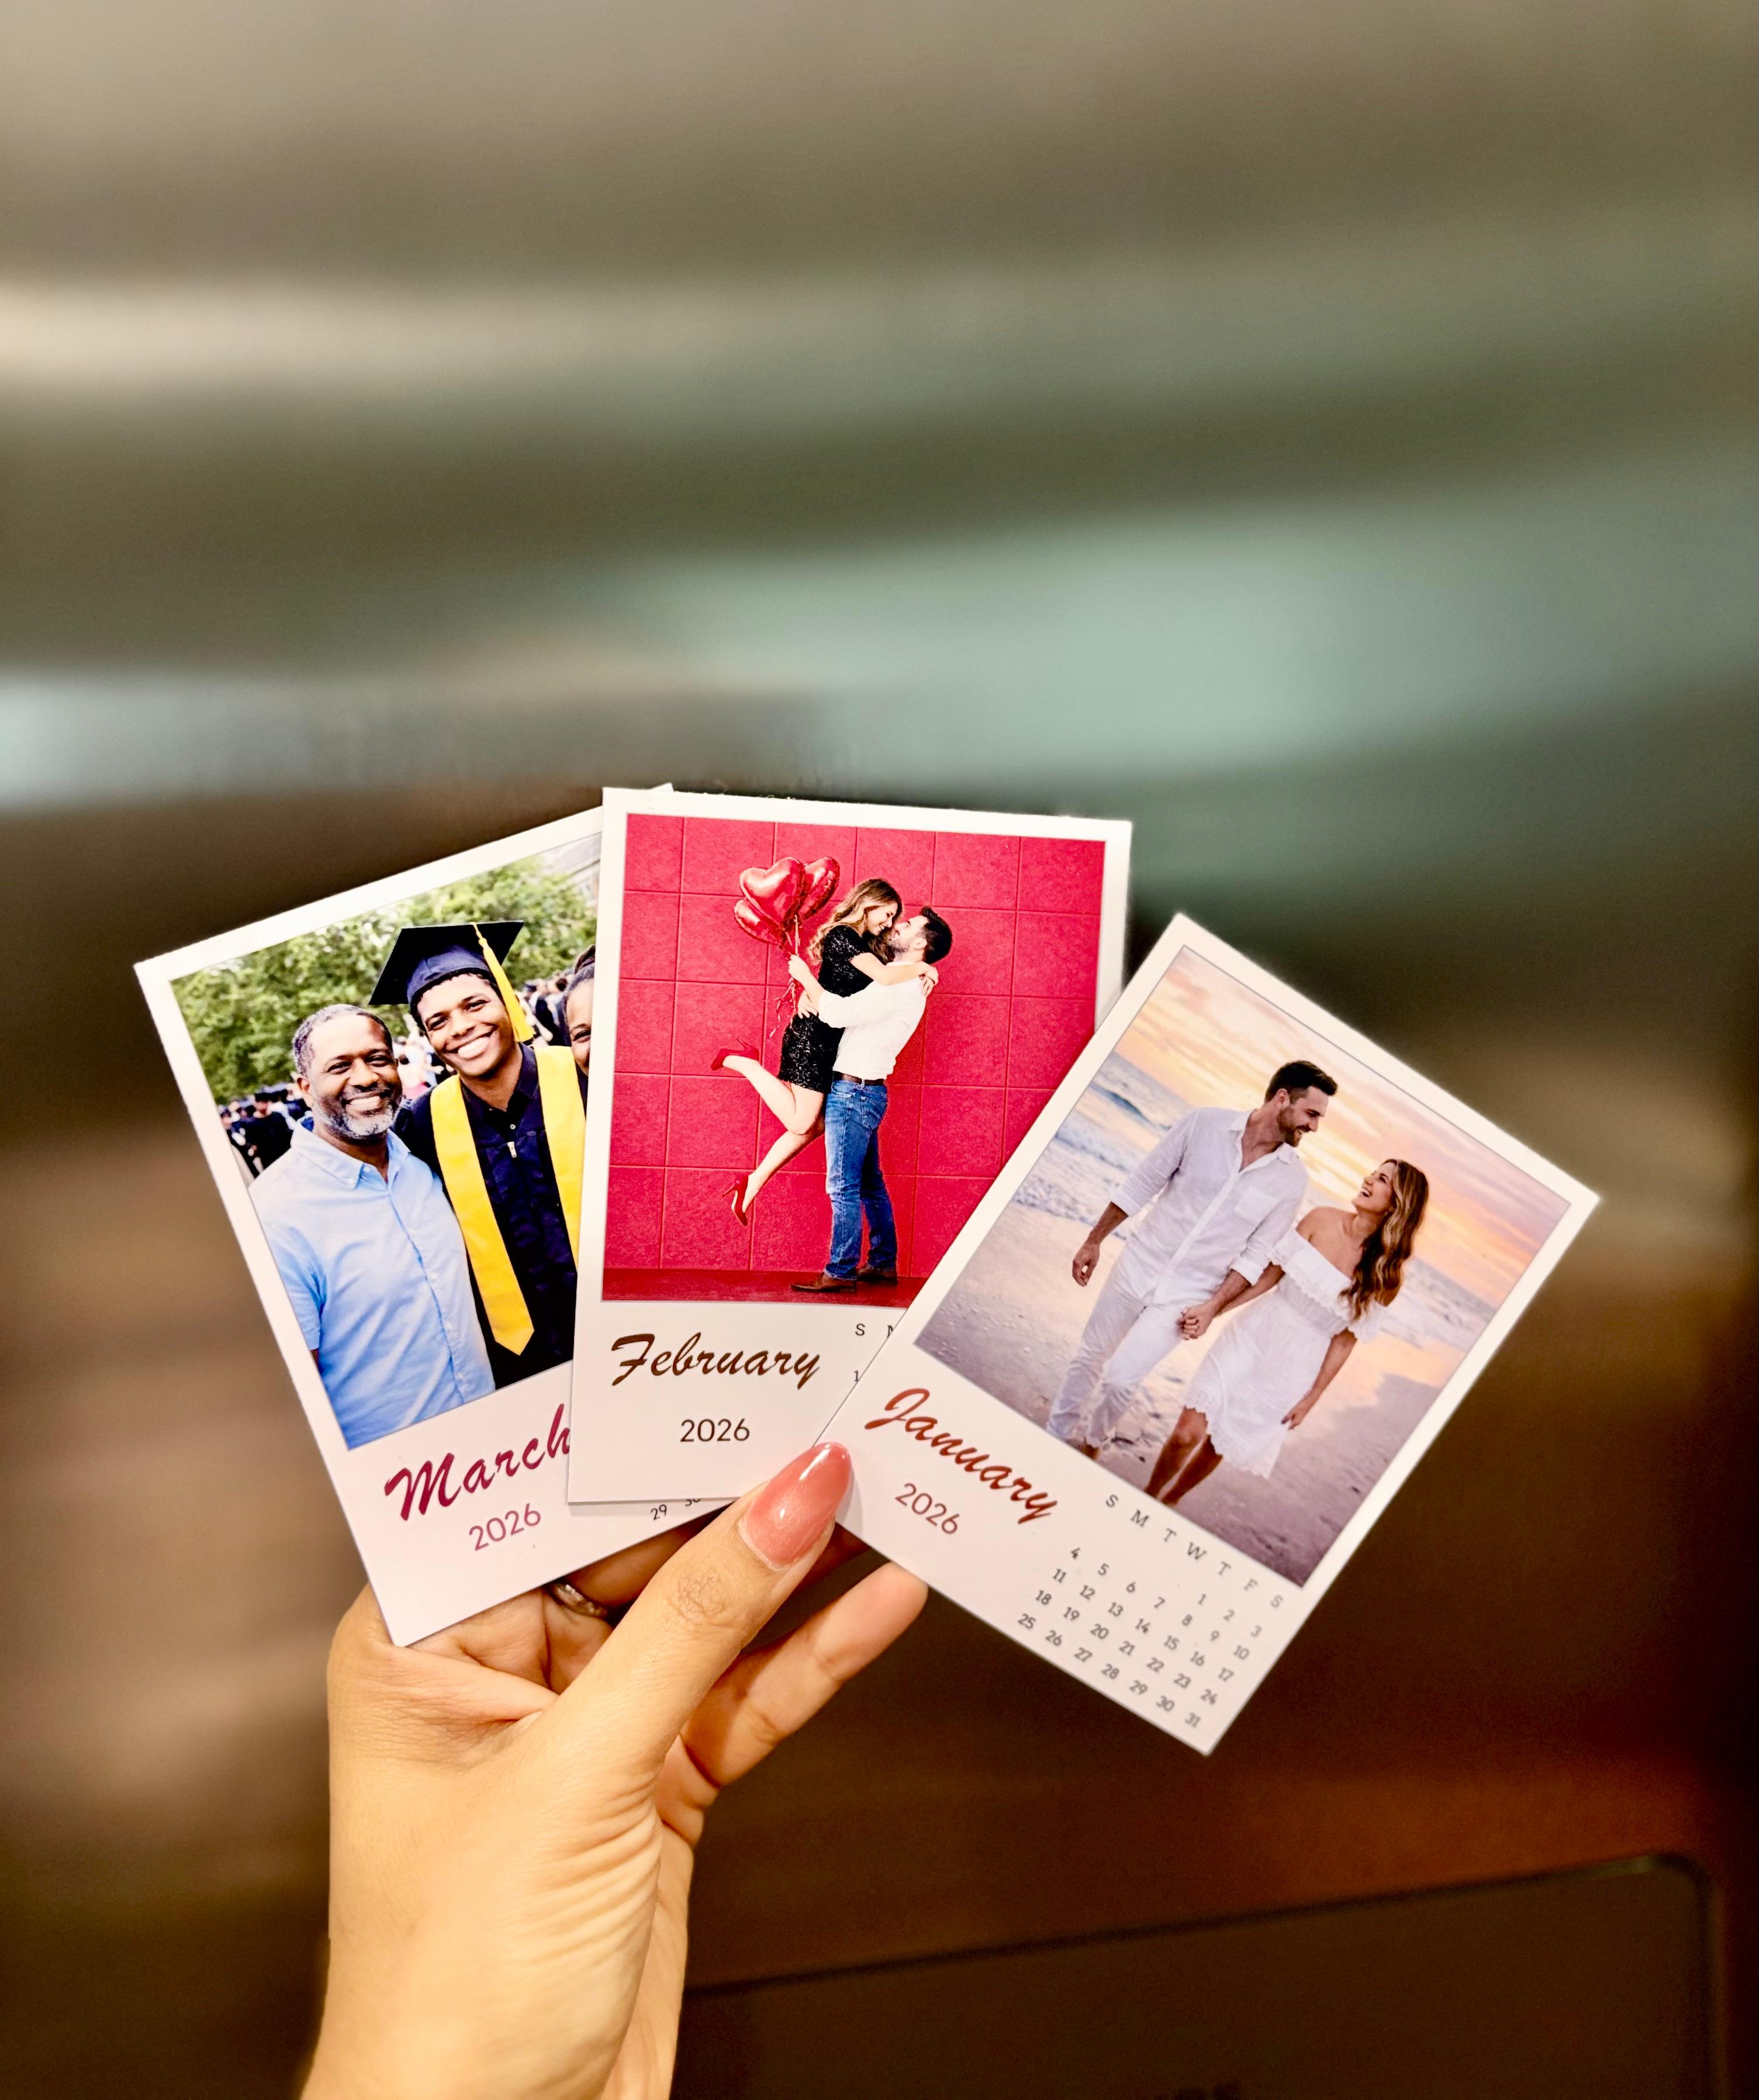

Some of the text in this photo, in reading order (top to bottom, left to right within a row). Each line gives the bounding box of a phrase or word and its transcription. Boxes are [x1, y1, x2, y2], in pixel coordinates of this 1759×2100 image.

[611, 1331, 821, 1390] February
[855, 1323, 866, 1336] S
[383, 1403, 571, 1521] March
[680, 1418, 751, 1443] 2026
[864, 1387, 1058, 1525] January
[469, 1503, 541, 1551] 2026
[650, 1504, 668, 1521] 29
[894, 1483, 960, 1535] 2026
[1105, 1494, 1283, 1608] S M T W T F S
[1052, 1568, 1235, 1682] 11 12 13 14 15 16 17
[1070, 1547, 1250, 1660] 4 5 6 7 8 9 10
[1197, 1593, 1262, 1639] 1 2 3
[1017, 1613, 1201, 1728] 25 26 27 28 29 30 31
[1035, 1590, 1218, 1705] 18 19 20 21 22 23 24
